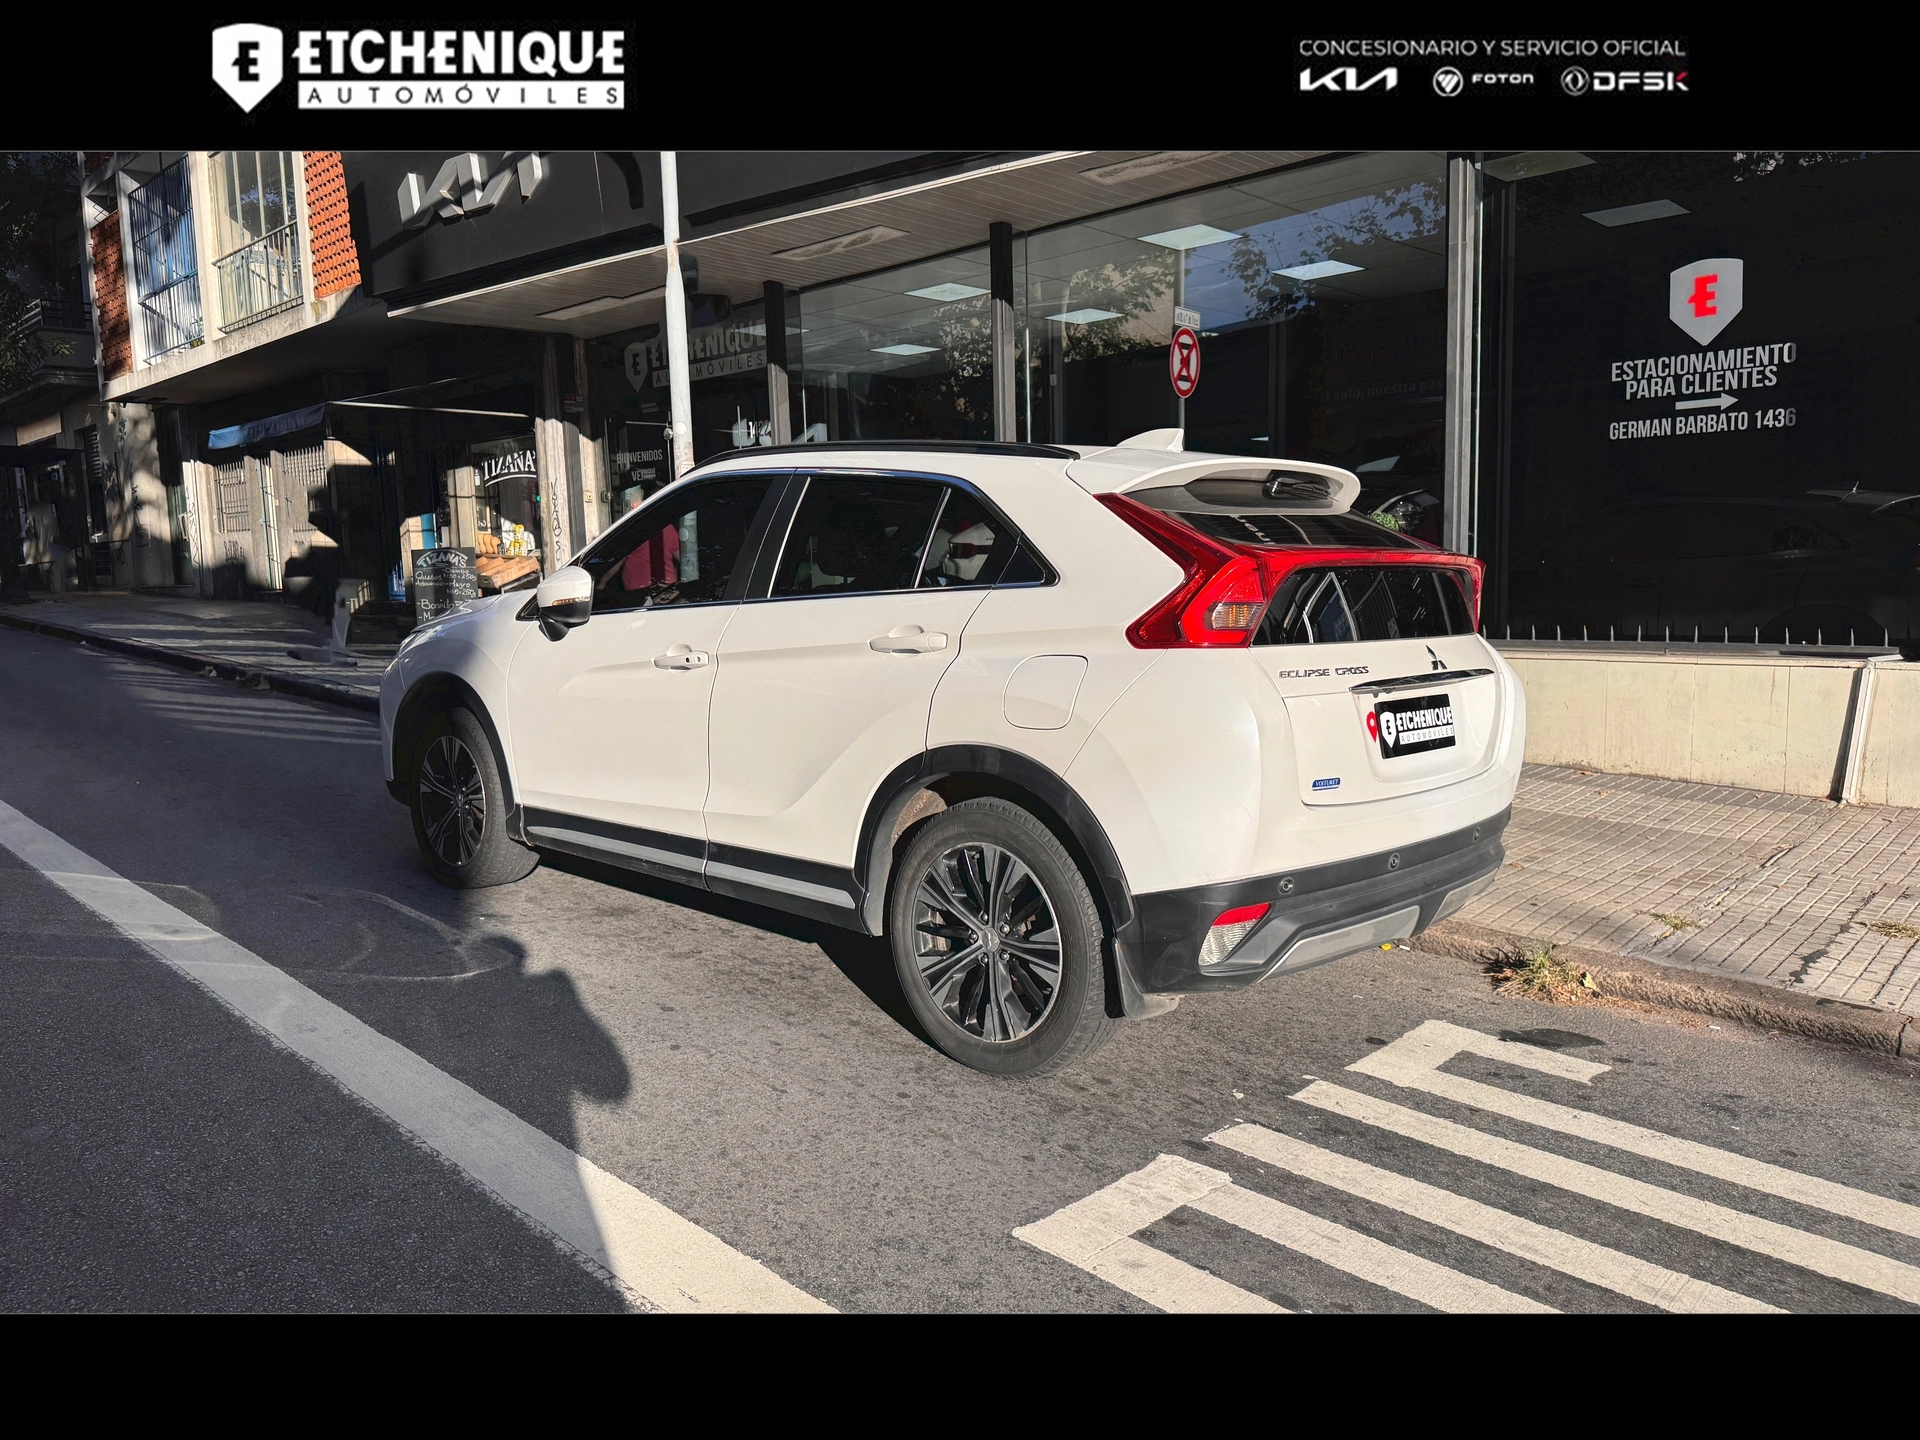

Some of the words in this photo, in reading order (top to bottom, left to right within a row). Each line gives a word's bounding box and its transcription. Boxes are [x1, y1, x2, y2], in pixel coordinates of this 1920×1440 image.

[655, 353, 764, 385] AUMÓVILES
[1611, 342, 1797, 382] ESTACIONAMIENTO
[1625, 377, 1676, 400] PARA
[1681, 365, 1778, 395] CLIENTES
[1609, 417, 1672, 440] GERMAN
[1675, 411, 1749, 435] BARBATO
[1755, 407, 1796, 429] 1436
[616, 449, 663, 464] BIENVENIDOS
[1278, 668, 1331, 679] ECLIPSE
[1334, 665, 1370, 677] CROSS
